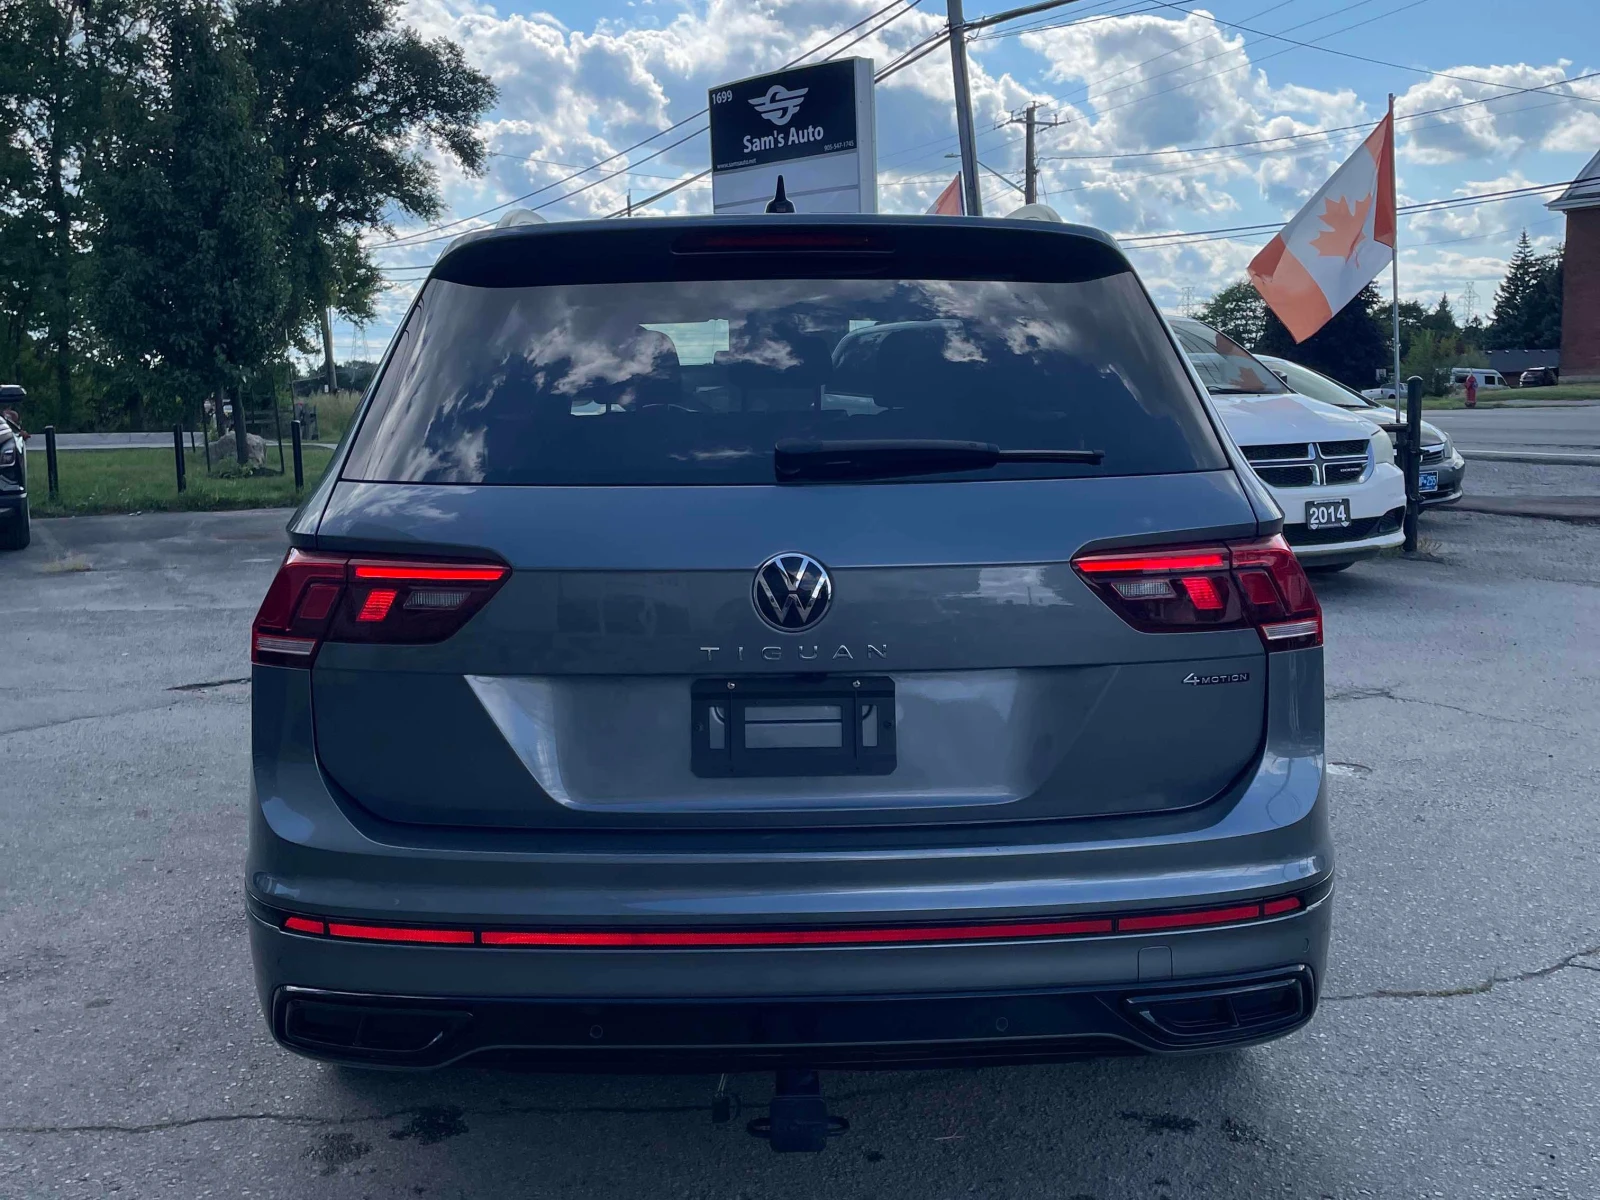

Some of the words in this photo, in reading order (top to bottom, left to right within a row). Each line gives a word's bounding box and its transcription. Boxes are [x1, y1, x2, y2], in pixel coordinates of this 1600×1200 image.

[711, 90, 733, 105] 1699
[743, 130, 785, 153] Sam's
[788, 125, 824, 146] Auto
[1309, 504, 1346, 524] 2014
[700, 644, 887, 661] TIGUAN
